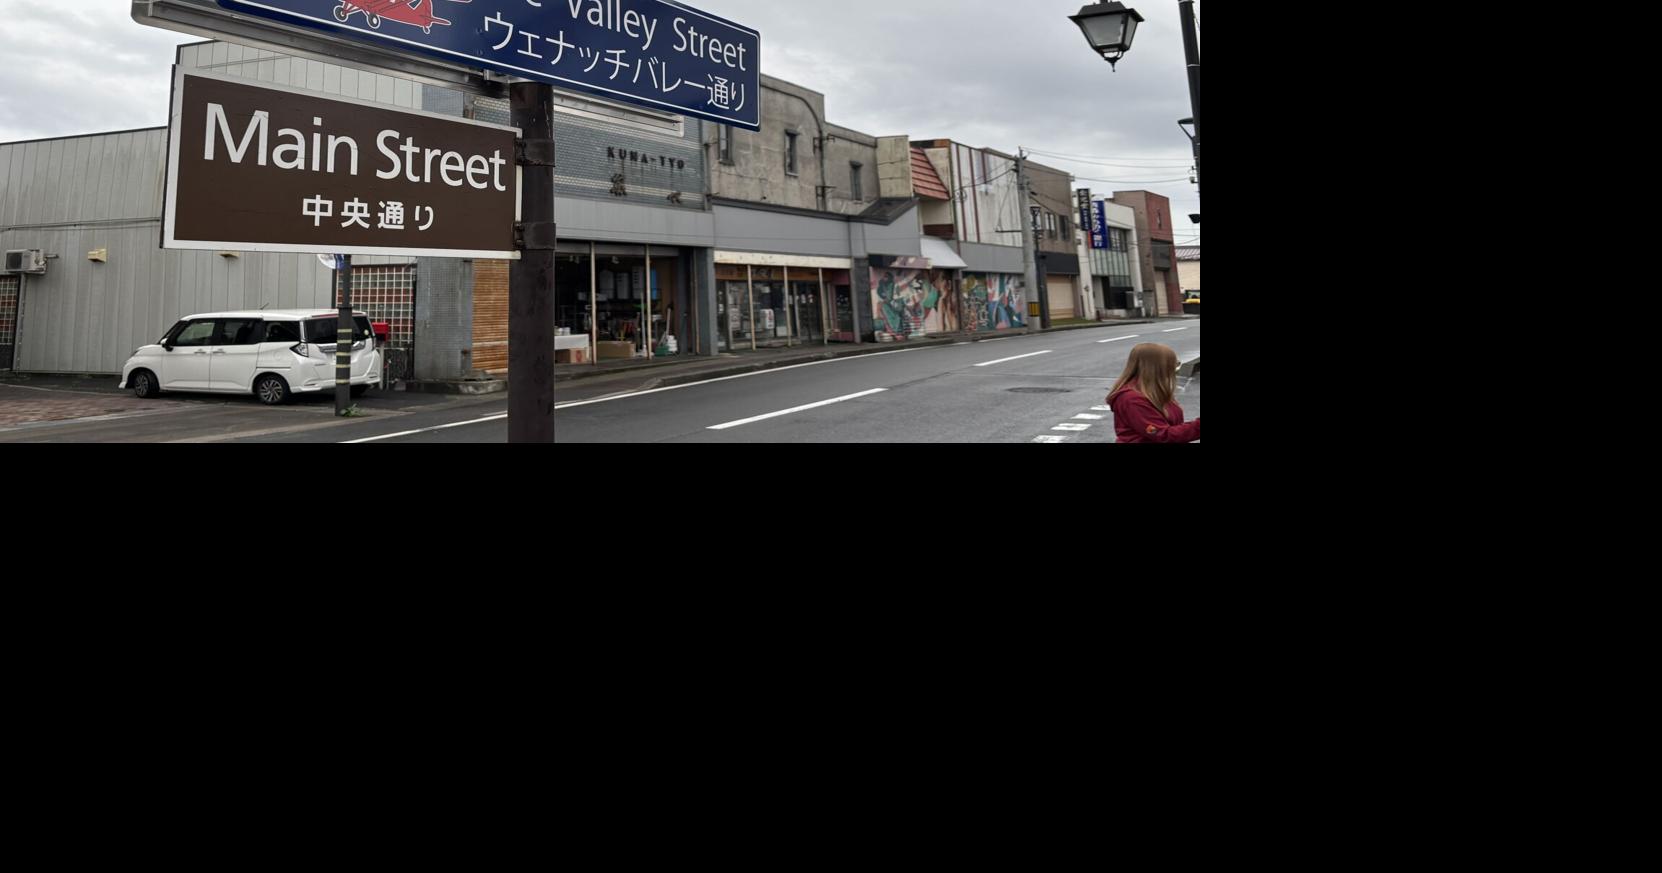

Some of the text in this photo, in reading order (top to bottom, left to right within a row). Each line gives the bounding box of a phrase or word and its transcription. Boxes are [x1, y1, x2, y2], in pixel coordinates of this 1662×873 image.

[484, 12, 744, 112] ウェナッチバレー通り
[673, 17, 746, 71] Street
[204, 102, 506, 191] Main Street
[302, 194, 434, 231] 中央通り
